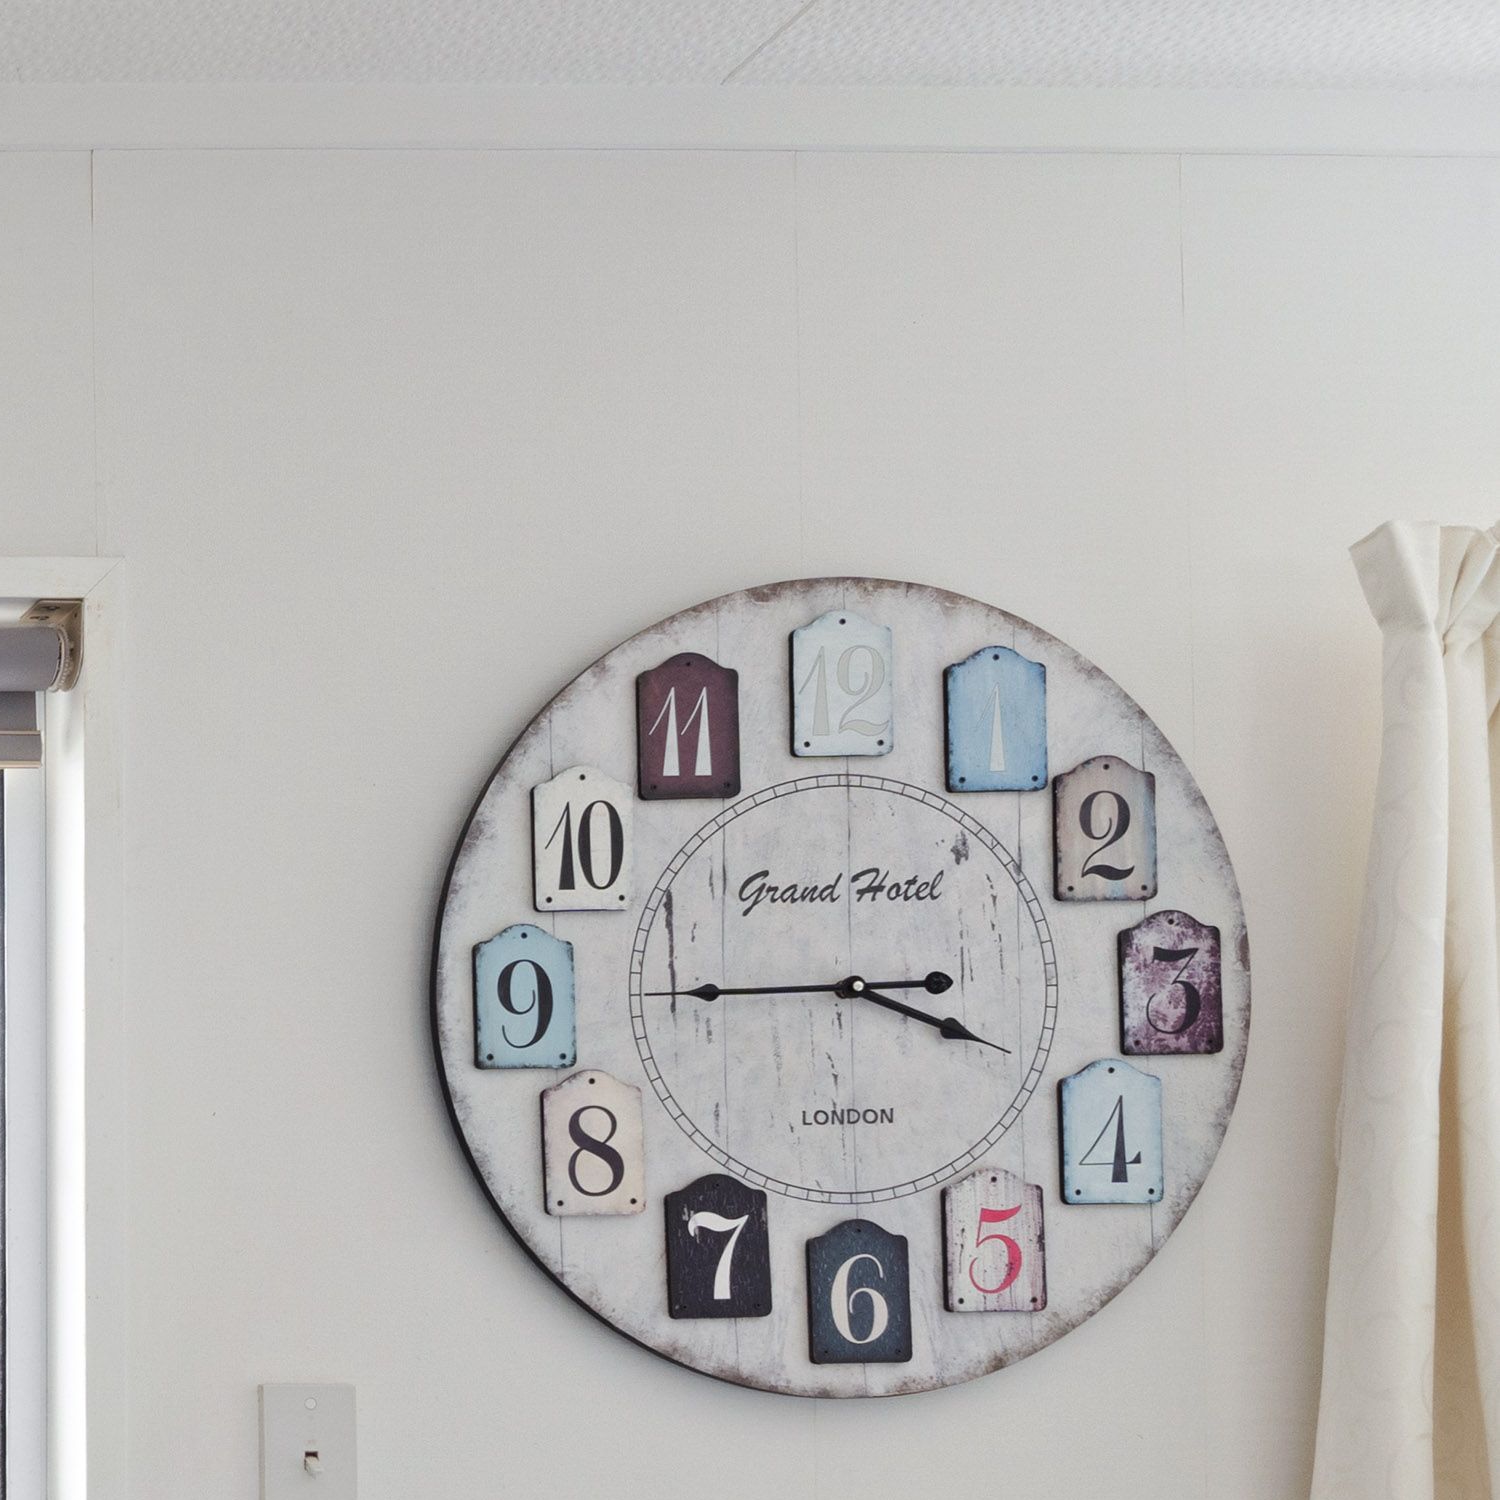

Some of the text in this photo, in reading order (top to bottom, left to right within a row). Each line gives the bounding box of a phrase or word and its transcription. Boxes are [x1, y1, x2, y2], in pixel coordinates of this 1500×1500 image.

[649, 686, 712, 777] 11
[798, 643, 890, 738] 12
[975, 682, 1006, 773] 1
[545, 799, 625, 891] 10
[1079, 790, 1136, 881] 2
[738, 868, 945, 917] Grand Hotel
[497, 959, 552, 1049] 9
[1145, 947, 1201, 1036] 3
[567, 1105, 626, 1197] 8
[801, 1108, 895, 1126] LONDON
[1079, 1095, 1142, 1184] 4
[688, 1210, 750, 1300] 7
[969, 1204, 1024, 1295] 5
[830, 1253, 890, 1344] 6
